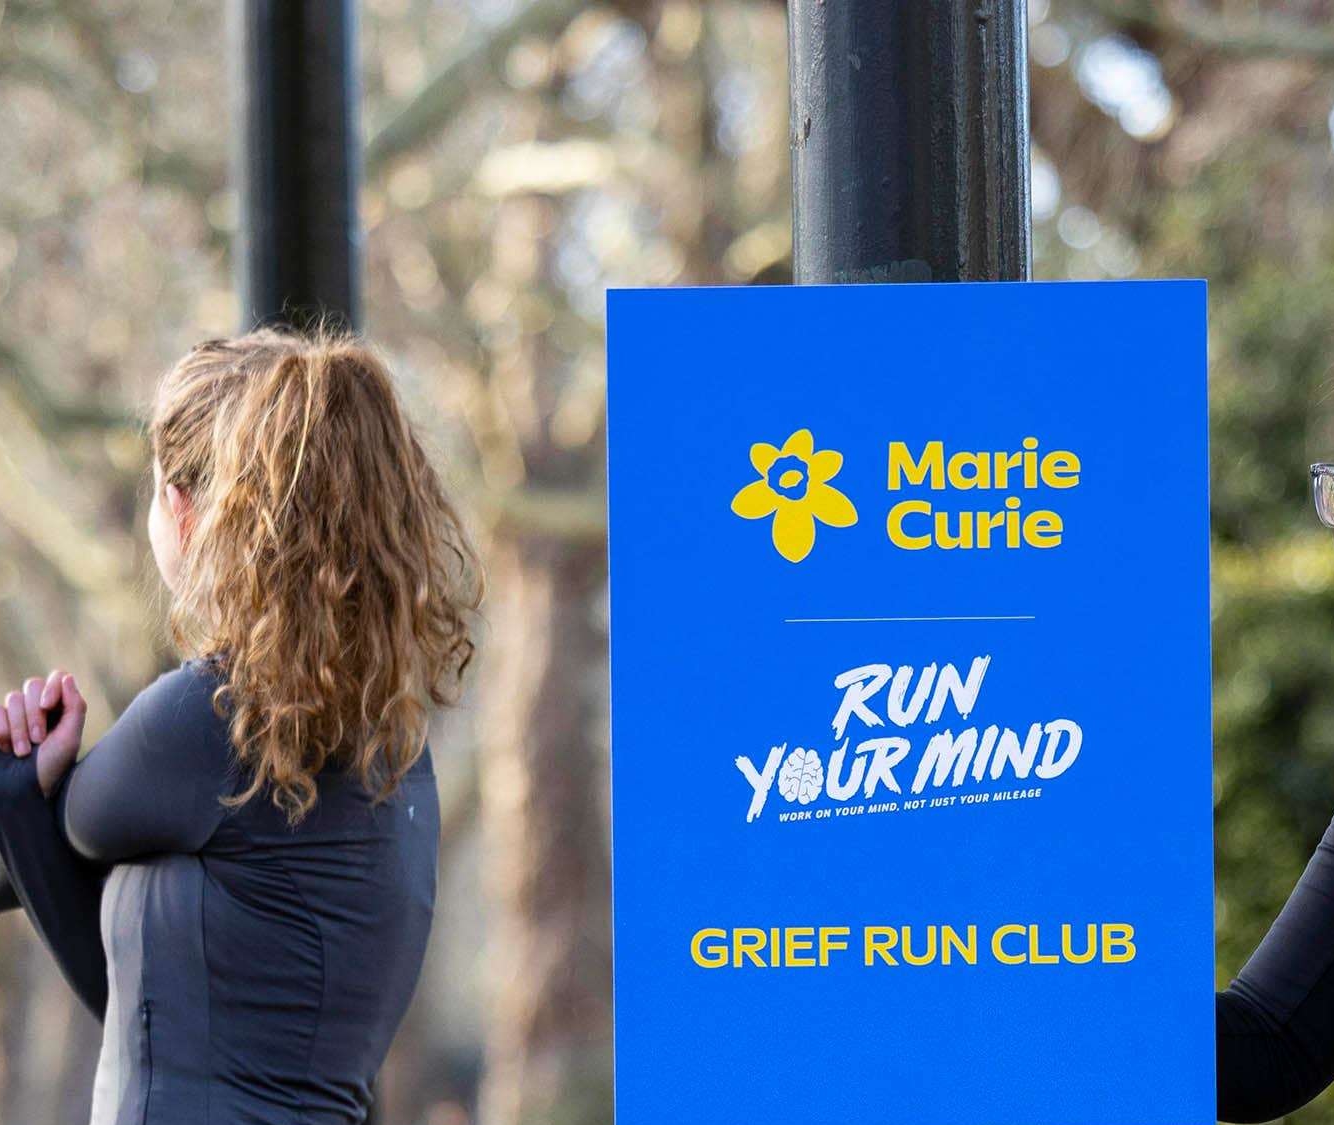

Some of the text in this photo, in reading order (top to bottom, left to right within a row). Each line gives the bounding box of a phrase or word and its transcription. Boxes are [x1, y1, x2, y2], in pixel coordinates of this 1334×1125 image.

[887, 437, 1081, 491] Marie
[886, 497, 1064, 551] Curie
[831, 654, 992, 741] RUN
[910, 719, 1083, 795] MIND
[779, 810, 812, 822] WORK
[815, 808, 832, 818] ON
[834, 805, 865, 817] YOUR
[903, 799, 927, 810] NOT
[929, 796, 957, 808] JUST
[960, 793, 990, 805] YOUR
[992, 788, 1042, 801] MILEAGE
[690, 923, 1137, 969] GRIEF RUN CLUB
